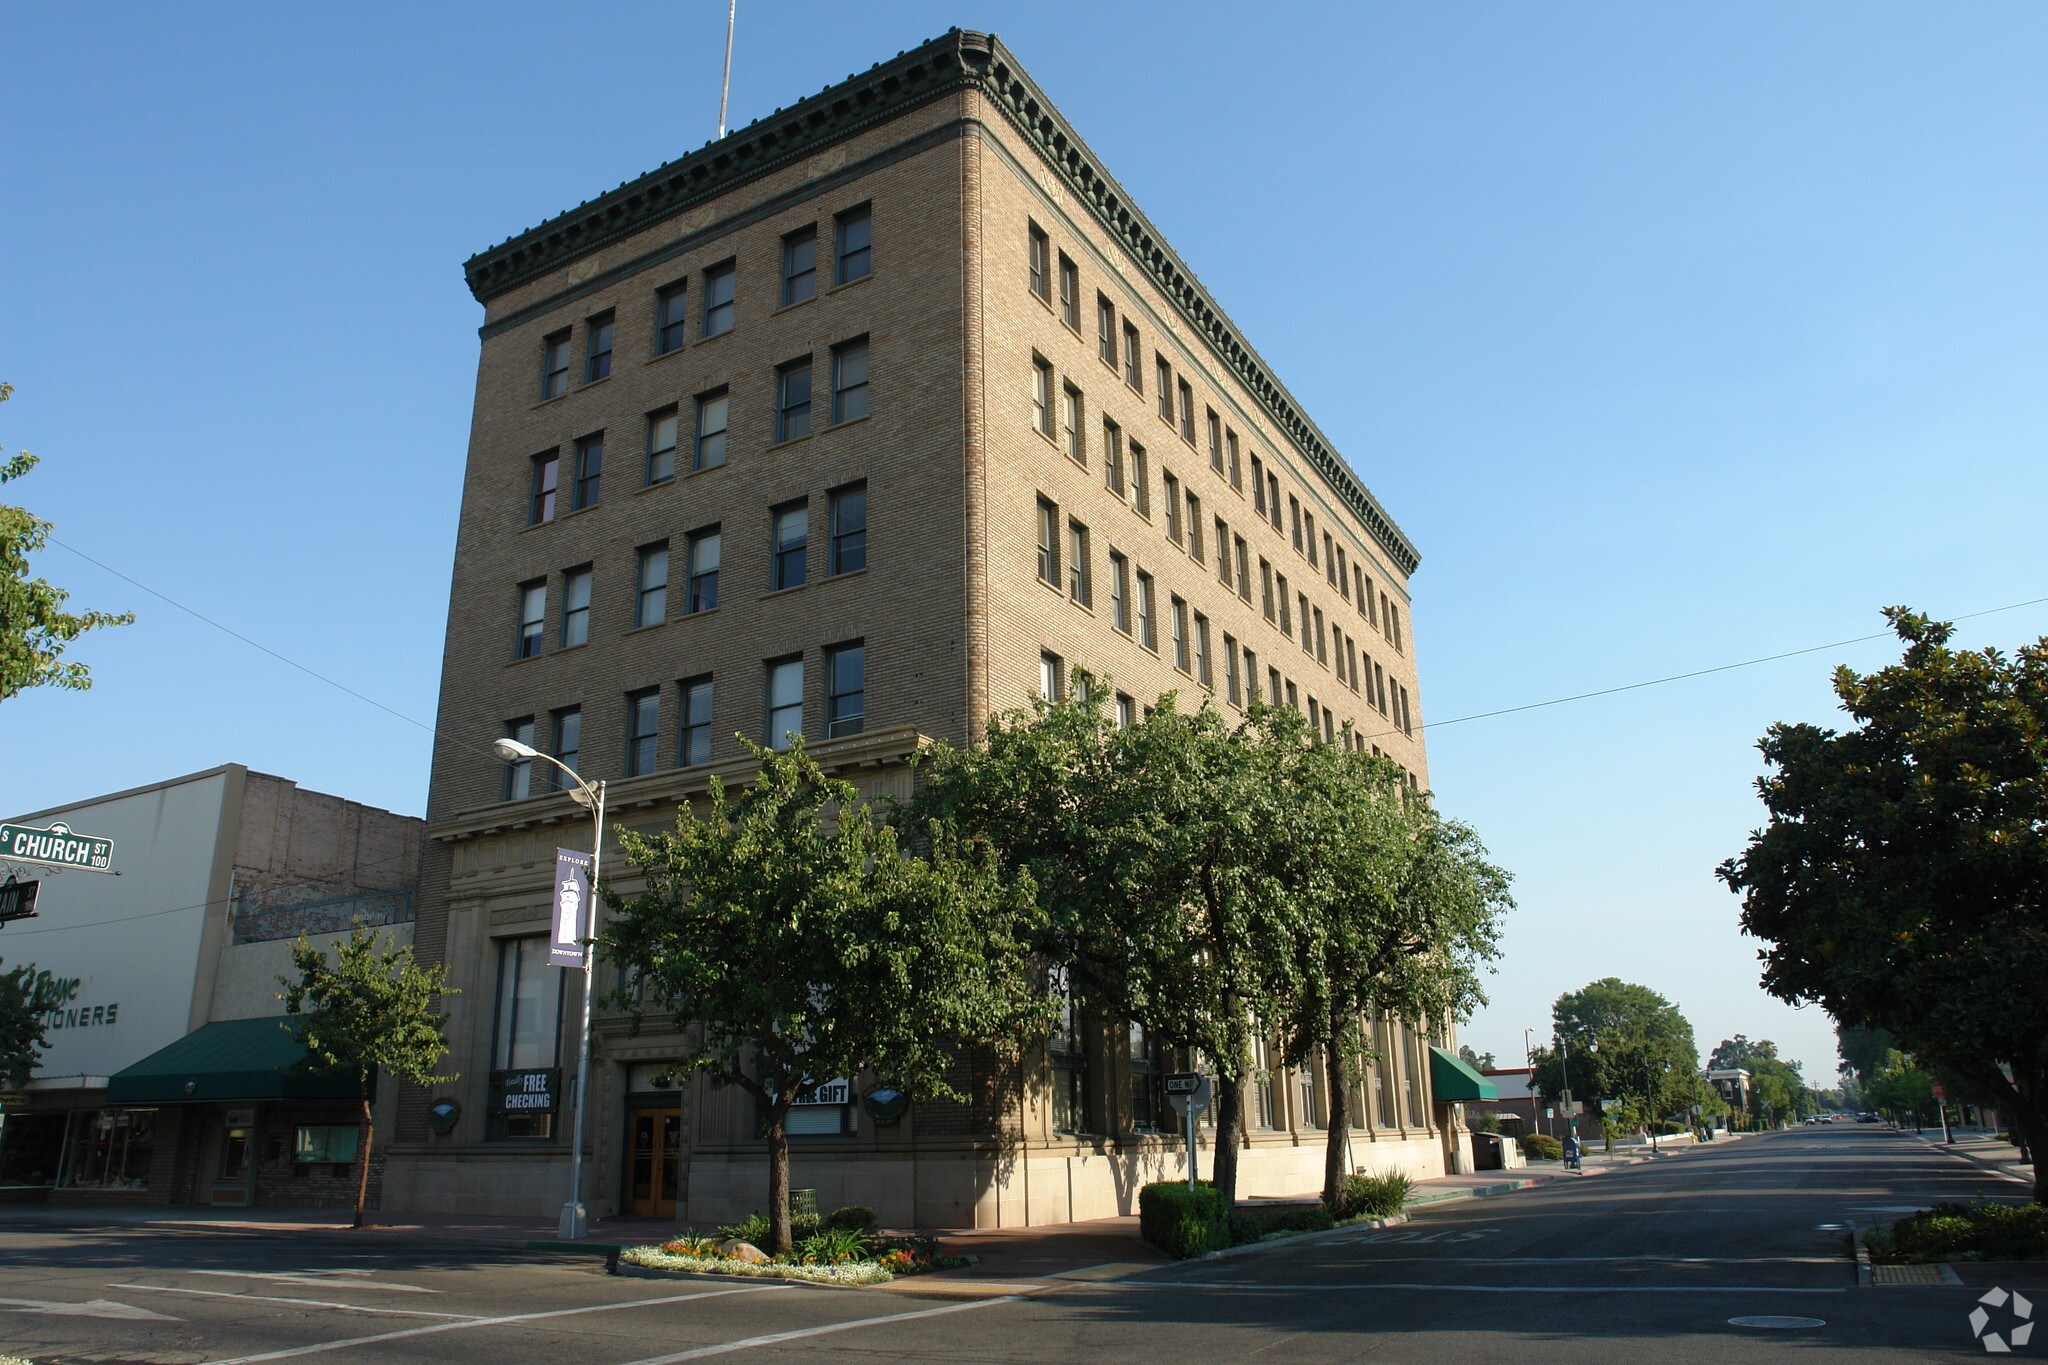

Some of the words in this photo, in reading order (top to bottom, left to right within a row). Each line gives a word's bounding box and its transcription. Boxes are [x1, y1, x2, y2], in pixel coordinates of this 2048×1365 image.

[2, 830, 9, 842] S
[14, 833, 90, 863] CHURCH
[94, 843, 108, 855] ST
[91, 855, 107, 867] 100
[559, 855, 588, 866] EXPLORE
[0, 890, 19, 913] AIN
[27, 886, 36, 898] ST
[551, 948, 583, 957] DOWNTOWN
[523, 1074, 547, 1092] FREE
[1169, 1080, 1183, 1089] ONE
[505, 1094, 550, 1109] CHECKING
[819, 1085, 847, 1103] GIFT
